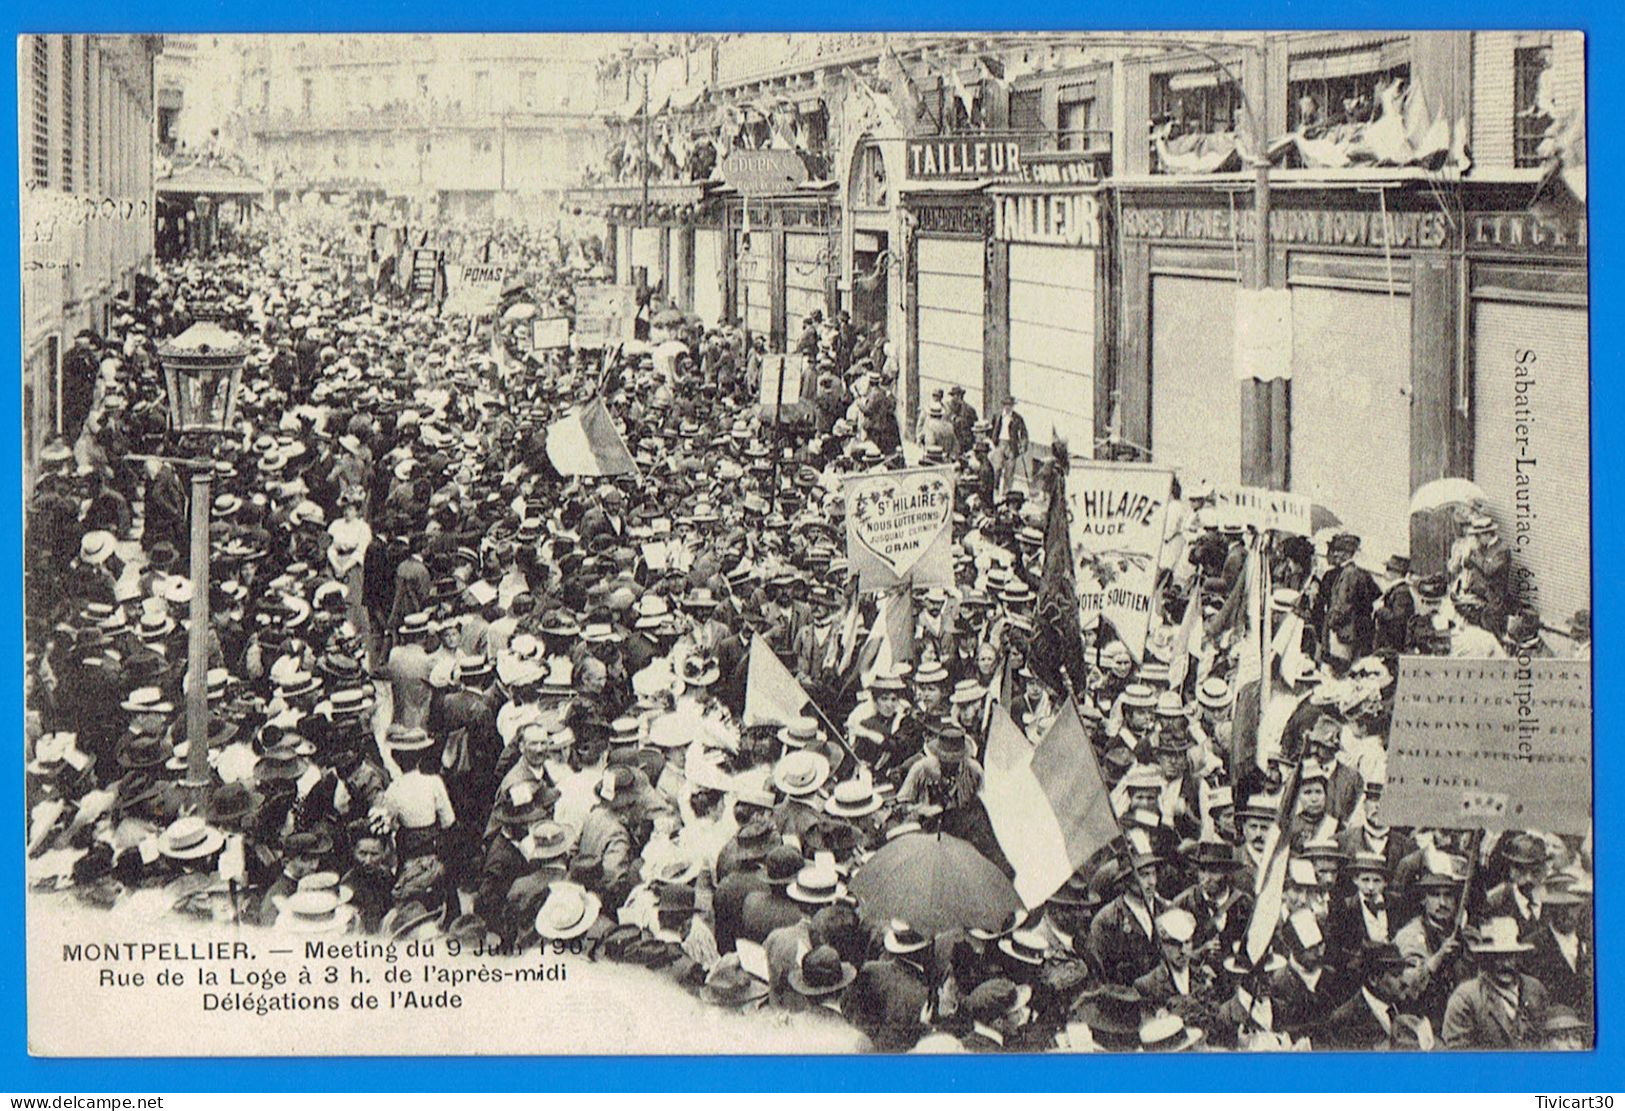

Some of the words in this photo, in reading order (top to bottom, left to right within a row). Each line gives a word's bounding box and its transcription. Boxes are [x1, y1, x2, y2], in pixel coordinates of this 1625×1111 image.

[910, 142, 1021, 174] TAILLEUR
[995, 194, 1100, 246] TAILLEUR
[464, 267, 503, 282] POMAS
[893, 493, 936, 512] HILAIRE
[1084, 490, 1162, 526] HILAIRE
[867, 520, 892, 532] NOUS
[1083, 523, 1126, 535] AUDE
[885, 540, 920, 554] GRAIN
[1107, 589, 1150, 612] SOUTIEN
